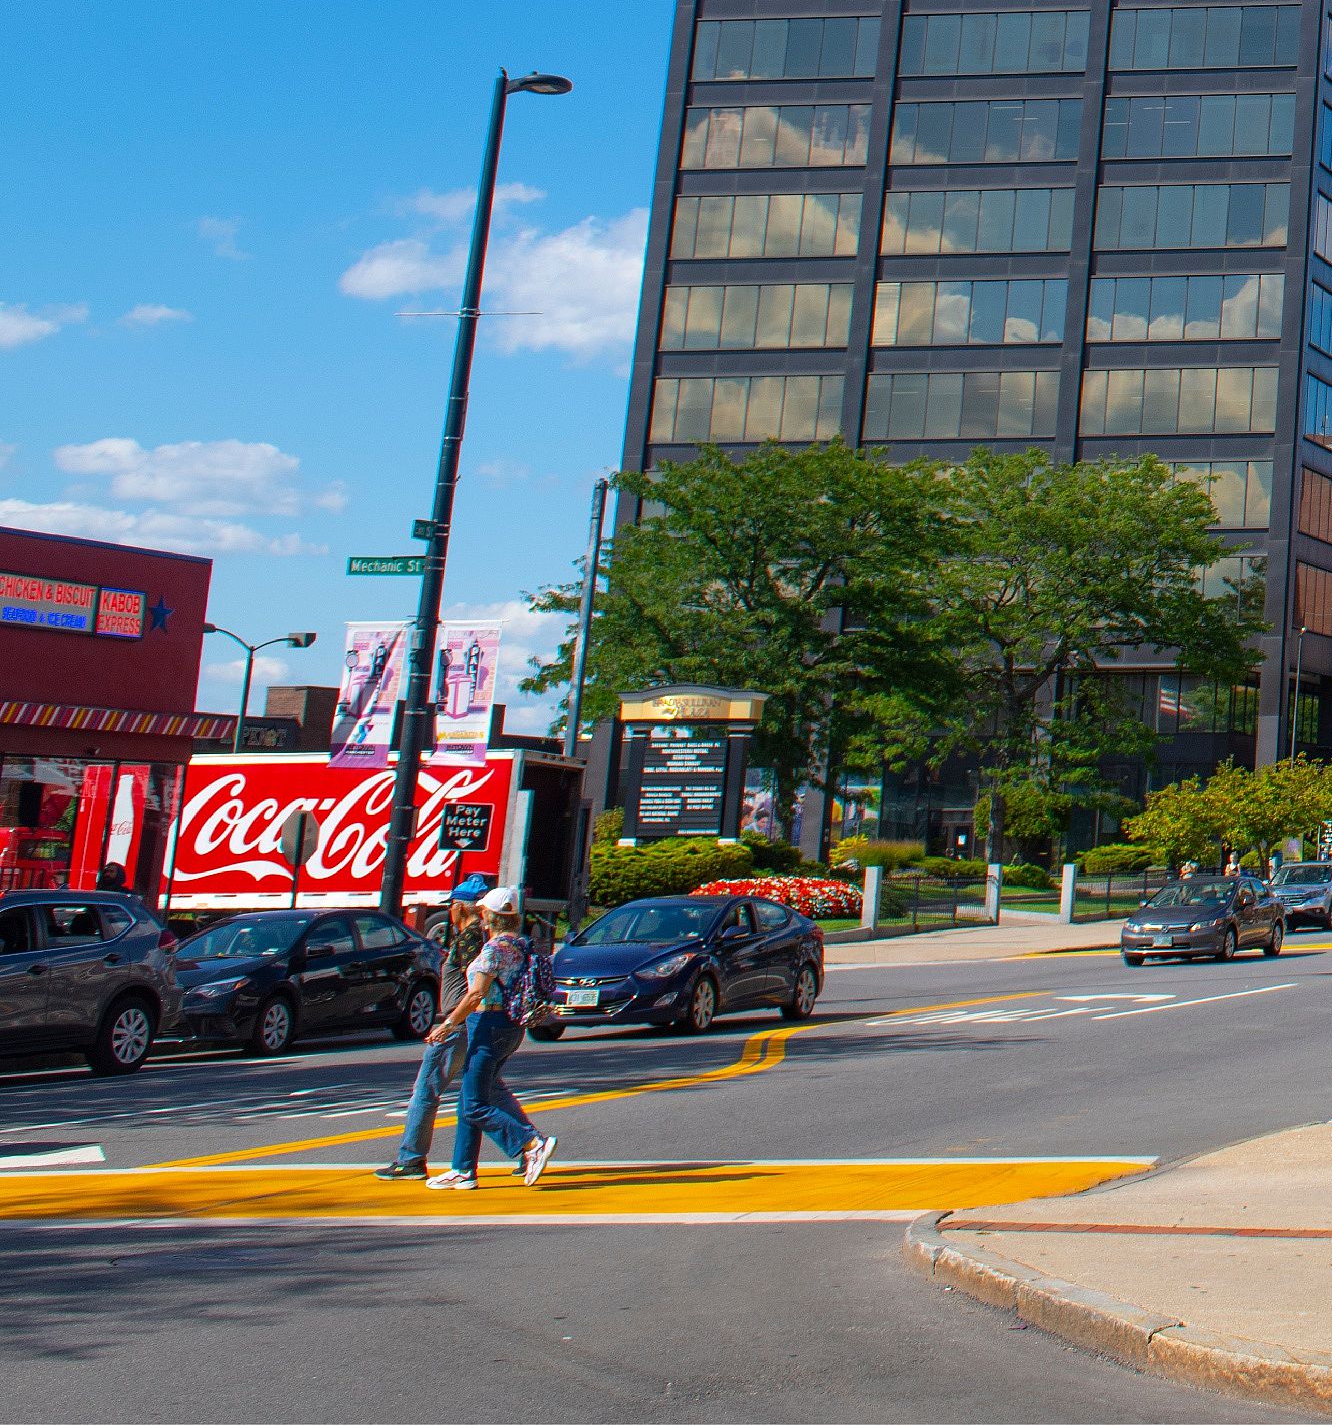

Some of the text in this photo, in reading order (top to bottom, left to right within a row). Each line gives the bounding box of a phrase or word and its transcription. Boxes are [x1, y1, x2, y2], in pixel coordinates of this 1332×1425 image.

[351, 559, 421, 573] Mechanic St
[54, 583, 97, 608] BISCUIT
[100, 591, 141, 615] KABOB
[97, 614, 140, 635] EXPRESS
[454, 803, 482, 818] Pay
[445, 815, 488, 828] Meter
[448, 826, 481, 838] Here
